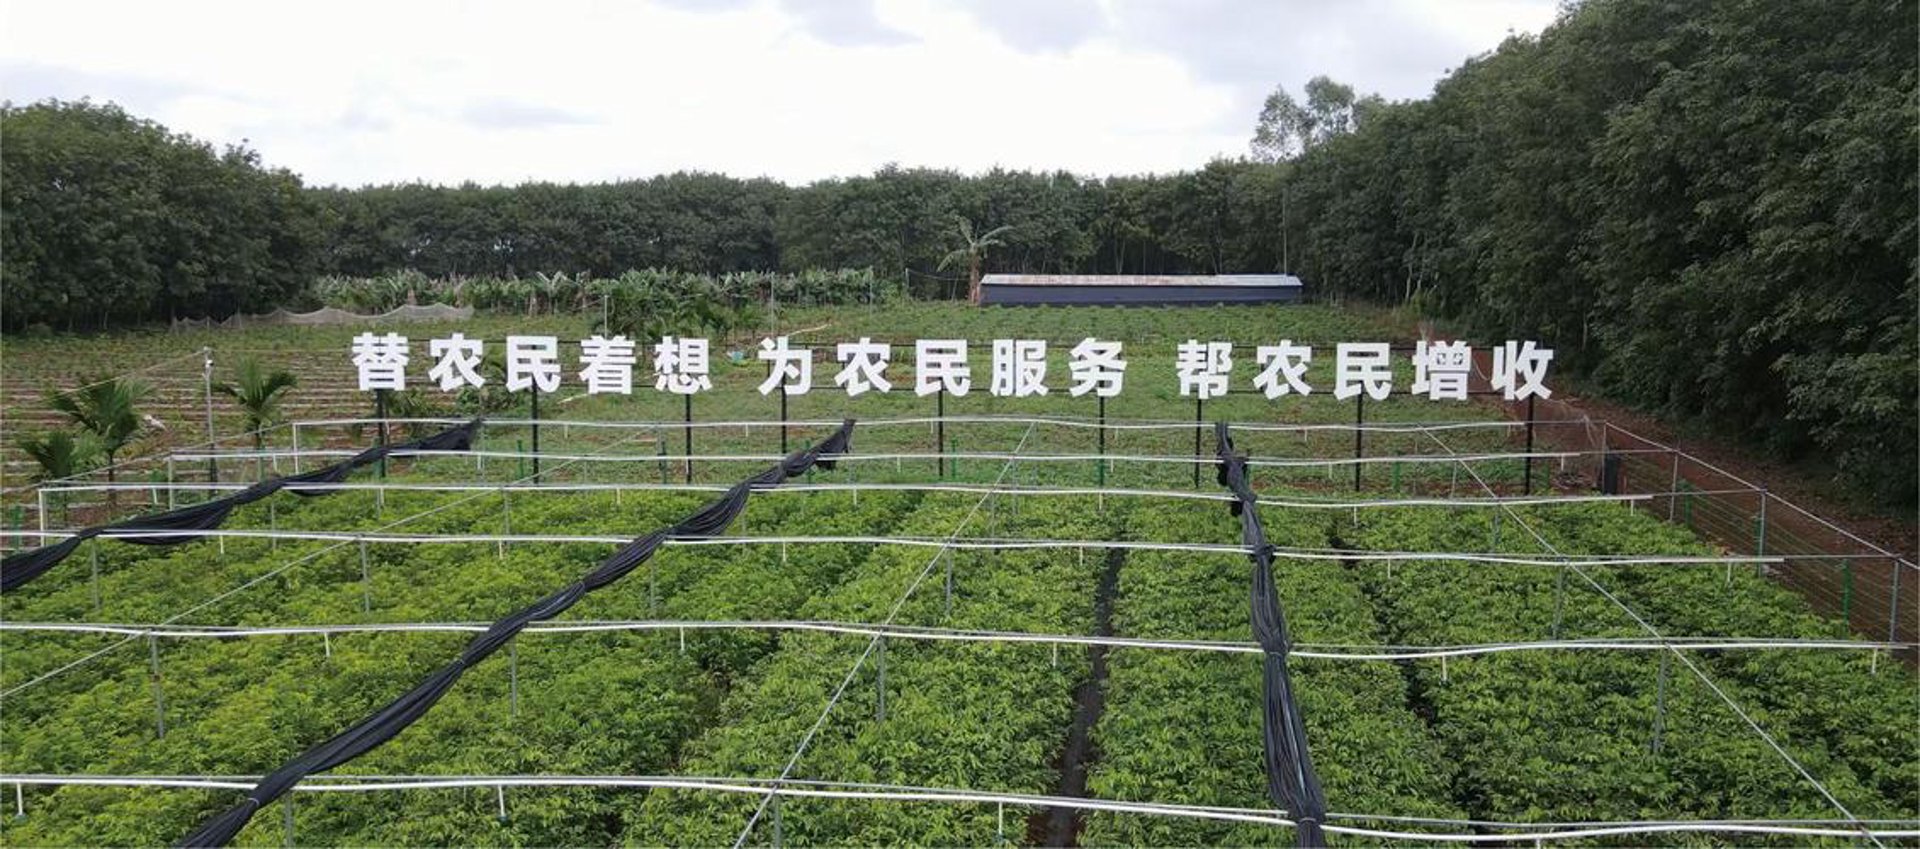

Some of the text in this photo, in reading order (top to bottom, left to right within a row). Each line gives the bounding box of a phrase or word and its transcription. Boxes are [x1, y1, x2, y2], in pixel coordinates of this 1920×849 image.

[352, 332, 1554, 400] 替农民着想 为农民服务 帮农民增收
